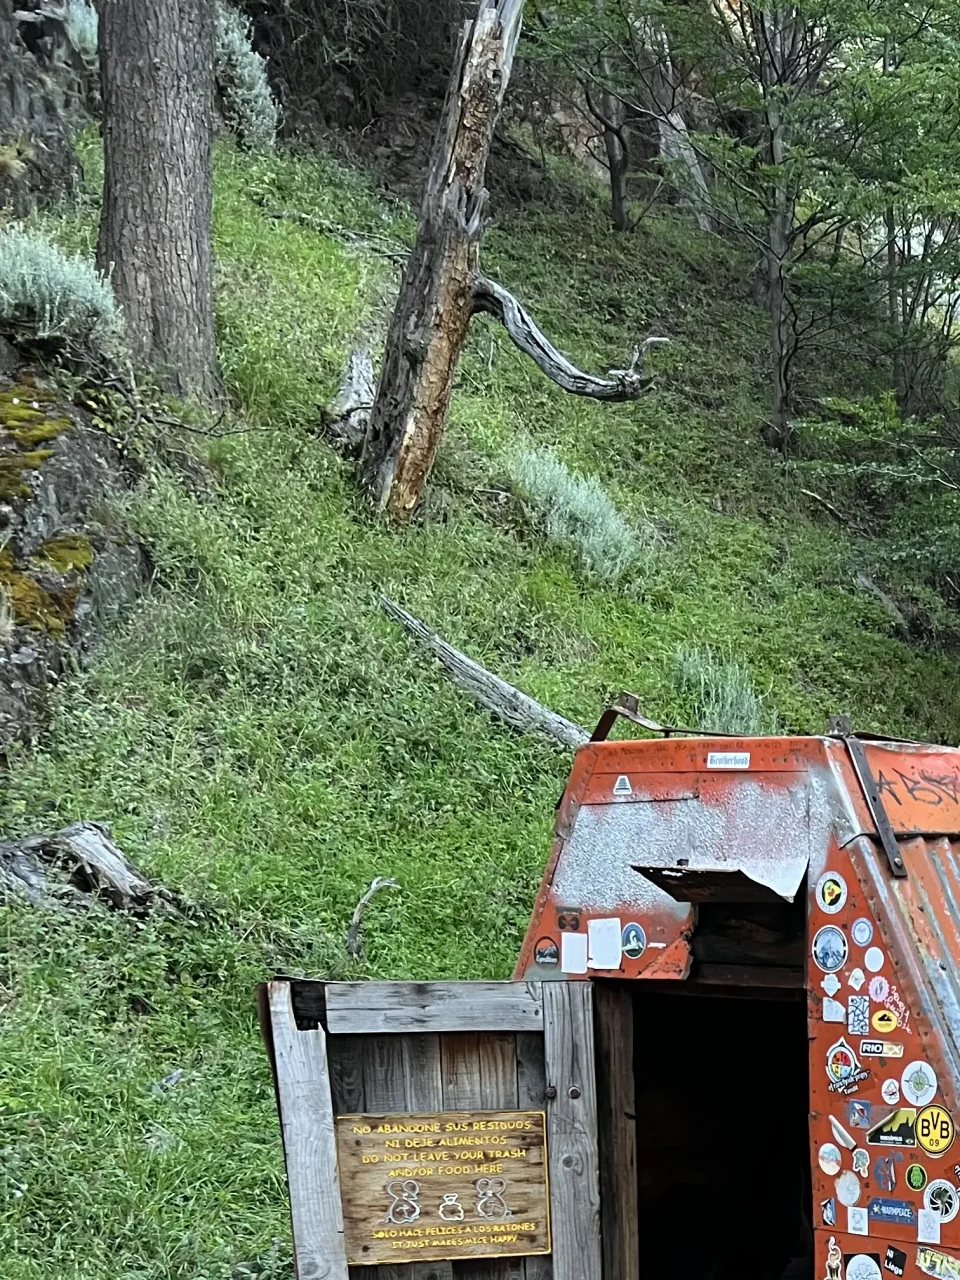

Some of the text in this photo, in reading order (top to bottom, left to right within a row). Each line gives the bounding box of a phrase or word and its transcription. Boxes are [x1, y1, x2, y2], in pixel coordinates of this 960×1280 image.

[353, 1120, 531, 1134] NO ABANDONE SUS RESIDUOS
[921, 1111, 950, 1139] BVB
[385, 1135, 507, 1148] NI DEJE ALIMENTOS
[929, 1138, 940, 1147] 09
[362, 1149, 526, 1164] DO NOT LEAVE YOUR TRASH
[388, 1163, 504, 1177] AND/OR FOOD HERE
[372, 1230, 398, 1239] SOLO
[399, 1229, 423, 1237] HACE
[425, 1226, 463, 1236] FELICES
[473, 1225, 491, 1233] LOS
[493, 1222, 536, 1232] RATONES
[404, 1239, 430, 1249] JUST
[432, 1238, 464, 1247] MAKES
[465, 1236, 488, 1244] MICE
[490, 1234, 517, 1244] HAPPY
